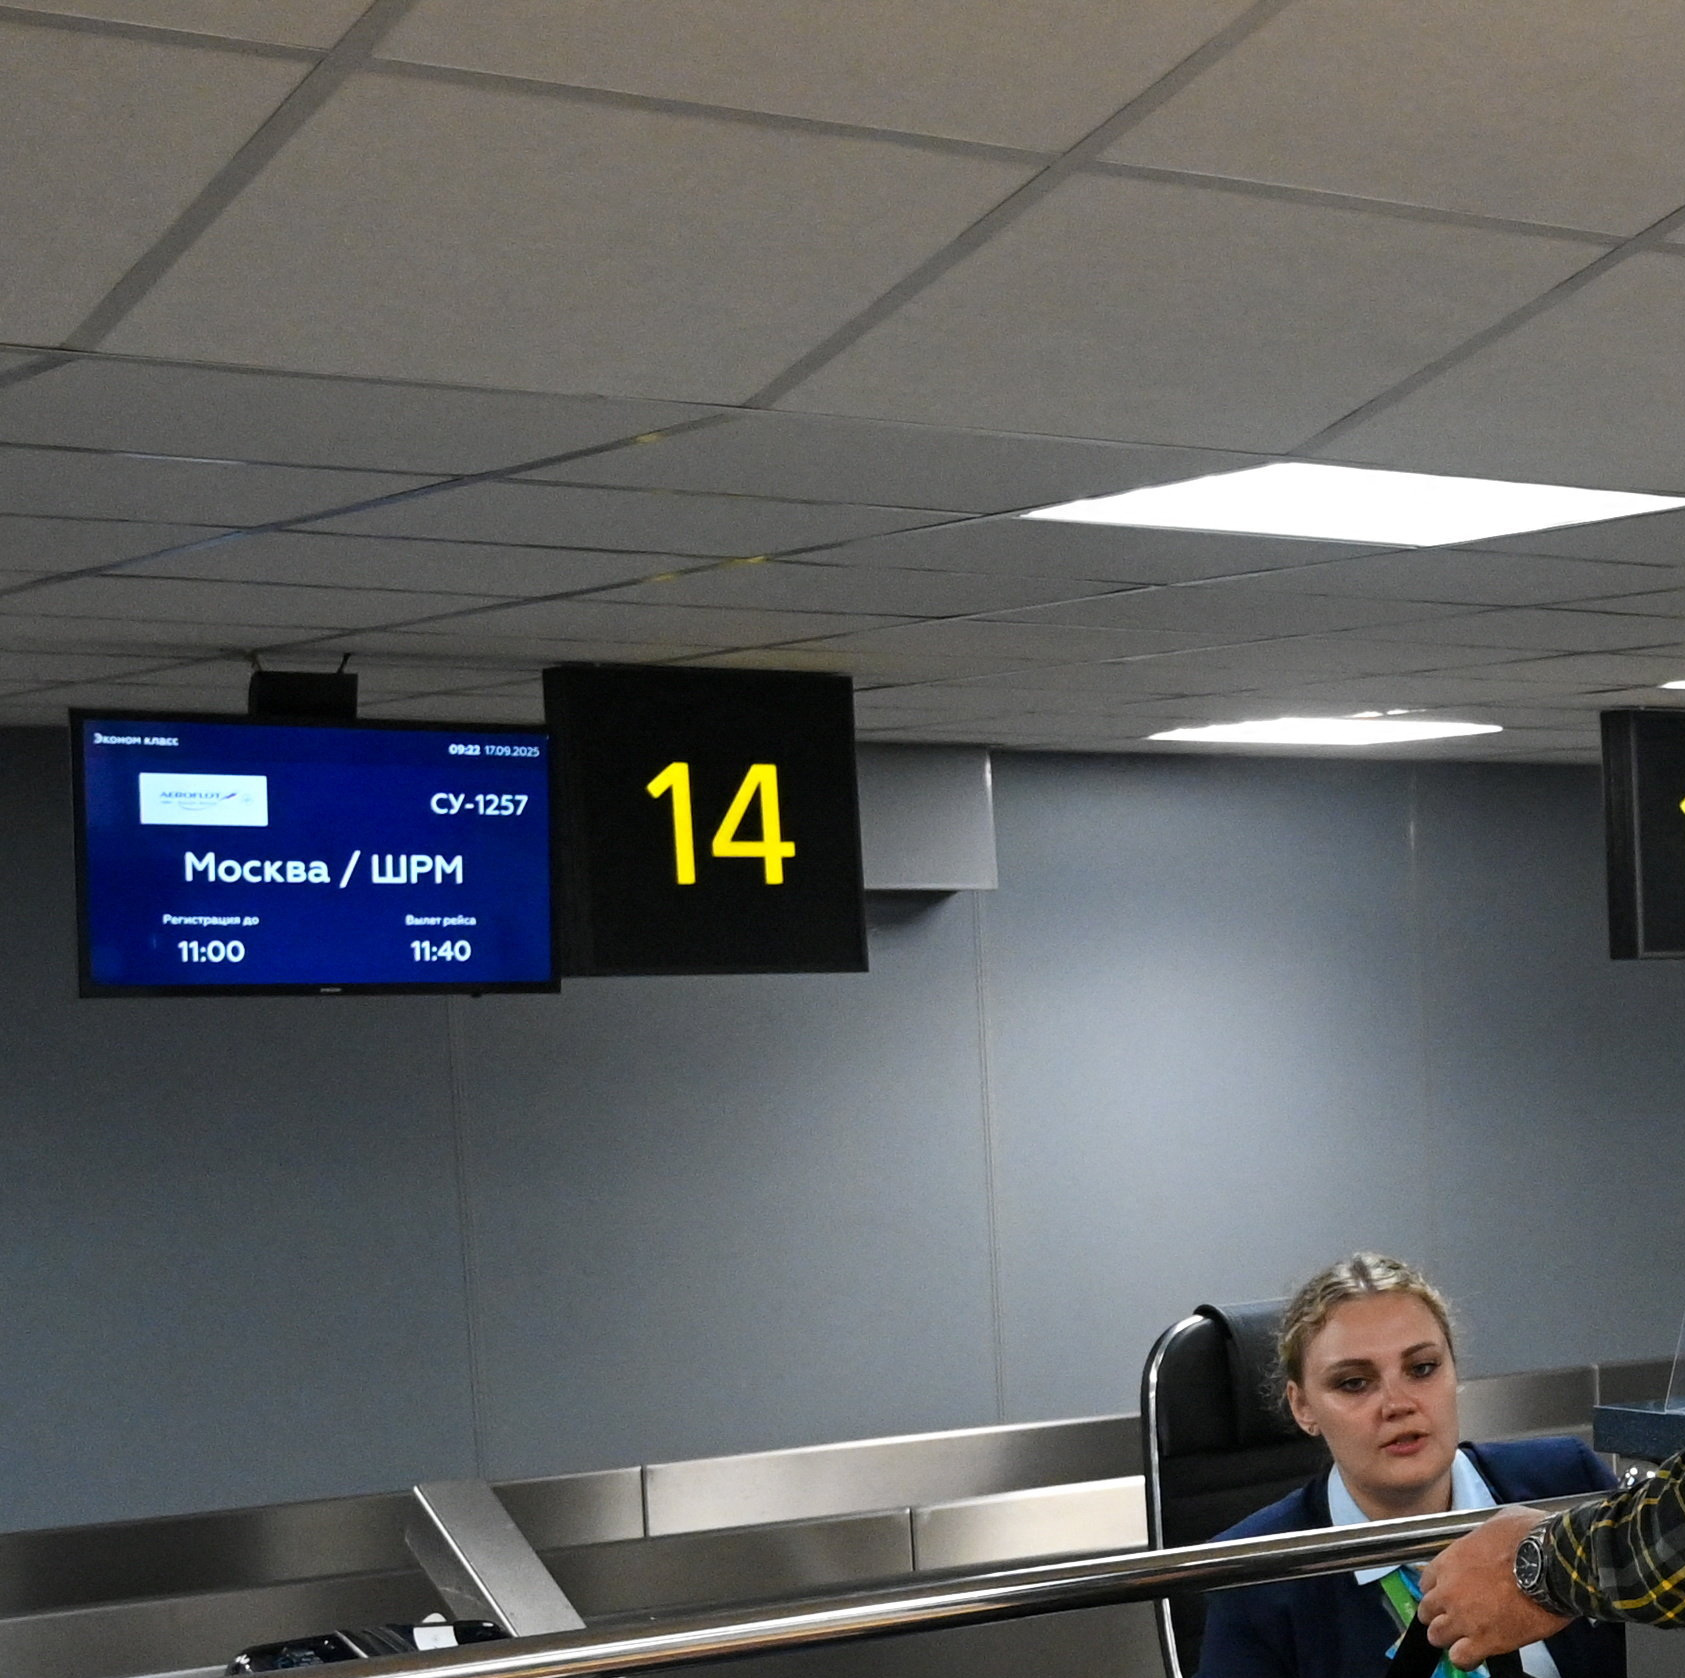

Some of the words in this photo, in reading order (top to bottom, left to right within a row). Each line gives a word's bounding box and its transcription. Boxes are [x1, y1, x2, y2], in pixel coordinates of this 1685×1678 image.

[94, 733, 141, 745] Эконом
[144, 736, 179, 747] класс
[448, 744, 481, 756] 09:22
[484, 745, 540, 757] 17.09.2025
[430, 792, 529, 816] СУ-1257
[645, 761, 796, 886] 14
[184, 851, 331, 884] Москва
[339, 850, 361, 889] /
[371, 854, 464, 885] ШРМ
[162, 914, 241, 927] Регистрация
[243, 915, 260, 927] до
[405, 914, 441, 926] Вылет
[443, 914, 477, 928] рейса
[177, 940, 245, 963] 11:00
[410, 940, 472, 962] 11:40
